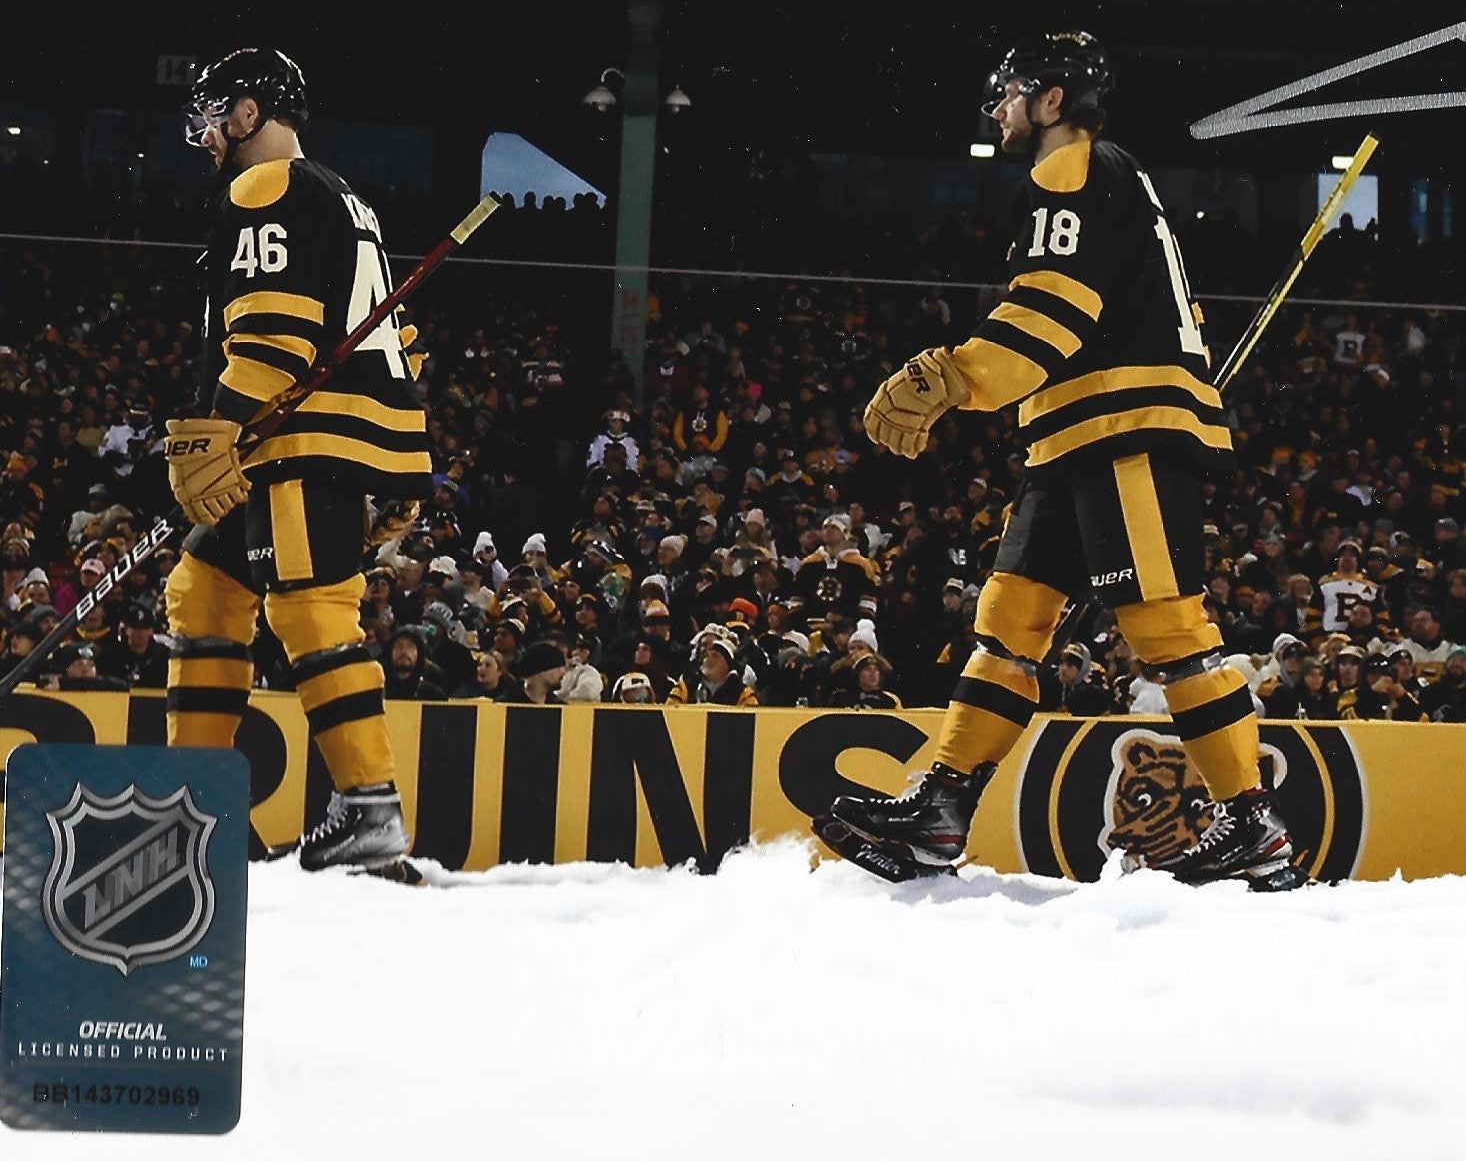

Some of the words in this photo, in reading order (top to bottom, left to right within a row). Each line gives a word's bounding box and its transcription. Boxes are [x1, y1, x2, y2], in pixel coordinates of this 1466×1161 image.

[230, 223, 288, 278] 46
[1028, 207, 1081, 257] 18
[346, 240, 409, 379] 4
[1154, 216, 1208, 356] 1
[0, 692, 930, 874] UINS
[83, 827, 182, 930] LNH
[190, 956, 208, 969] MD
[18, 1041, 121, 1059] LICENSED
[134, 1045, 228, 1062] PRODUCT
[79, 1020, 167, 1041] OFFICIAL
[33, 1082, 200, 1106] BB143702969
